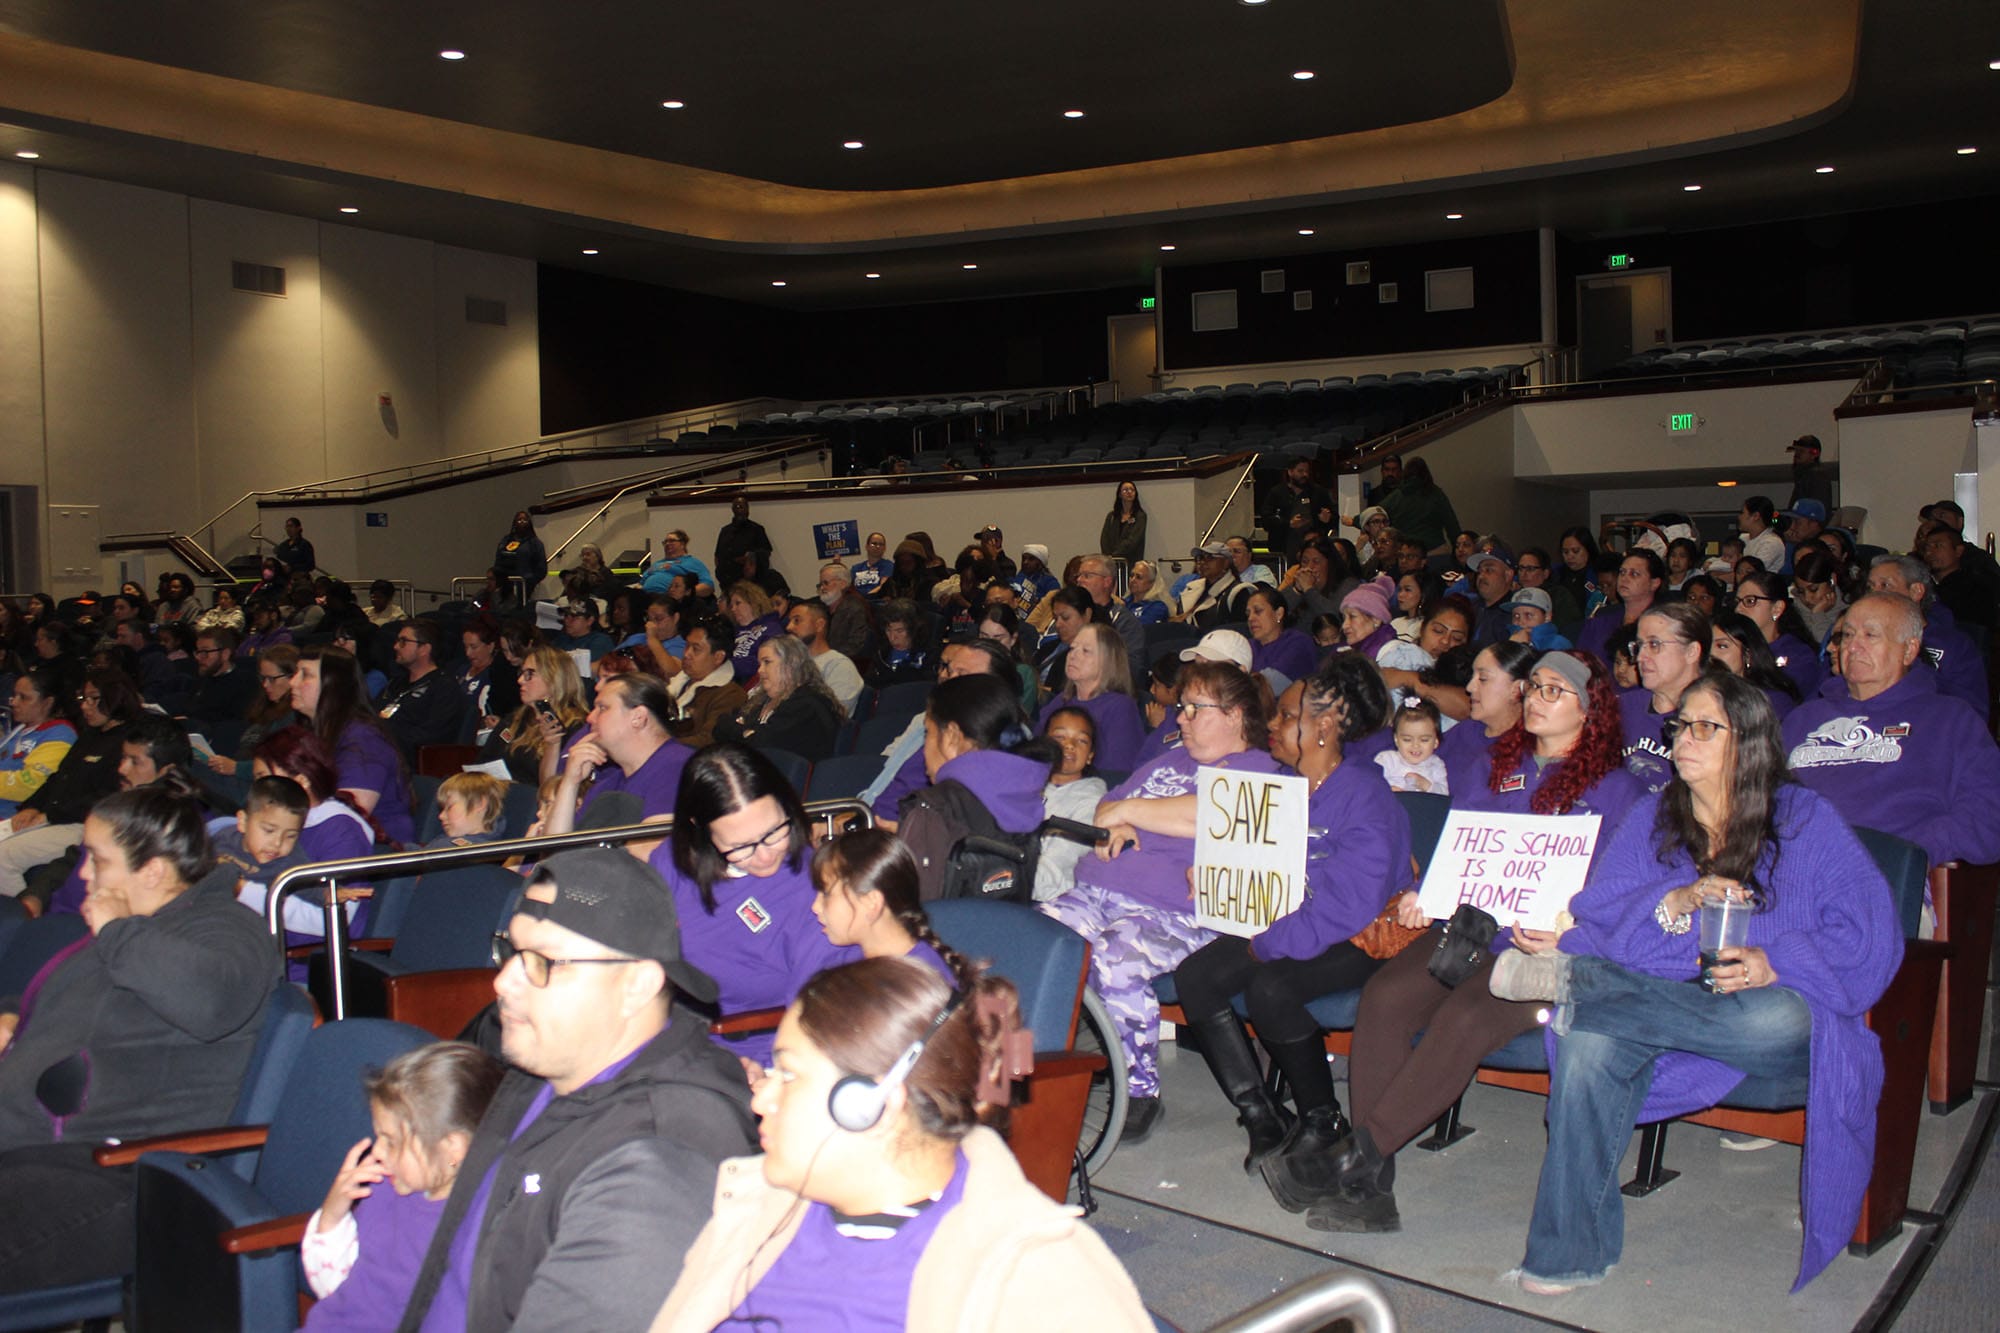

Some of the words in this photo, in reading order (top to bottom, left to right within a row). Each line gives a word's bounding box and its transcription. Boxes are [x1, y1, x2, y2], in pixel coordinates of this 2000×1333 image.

[1612, 255, 1626, 266] EXIT
[1143, 298, 1155, 308] EXIT
[1672, 414, 1693, 431] EXIT
[821, 523, 848, 535] WHAT'S
[828, 532, 841, 541] THE
[1208, 777, 1283, 845] SAVE
[1453, 827, 1507, 854] THIS
[1514, 831, 1591, 857] SCHOOL
[1460, 859, 1487, 877] IS
[1503, 860, 1547, 883] OUR
[1457, 882, 1537, 914] HOME
